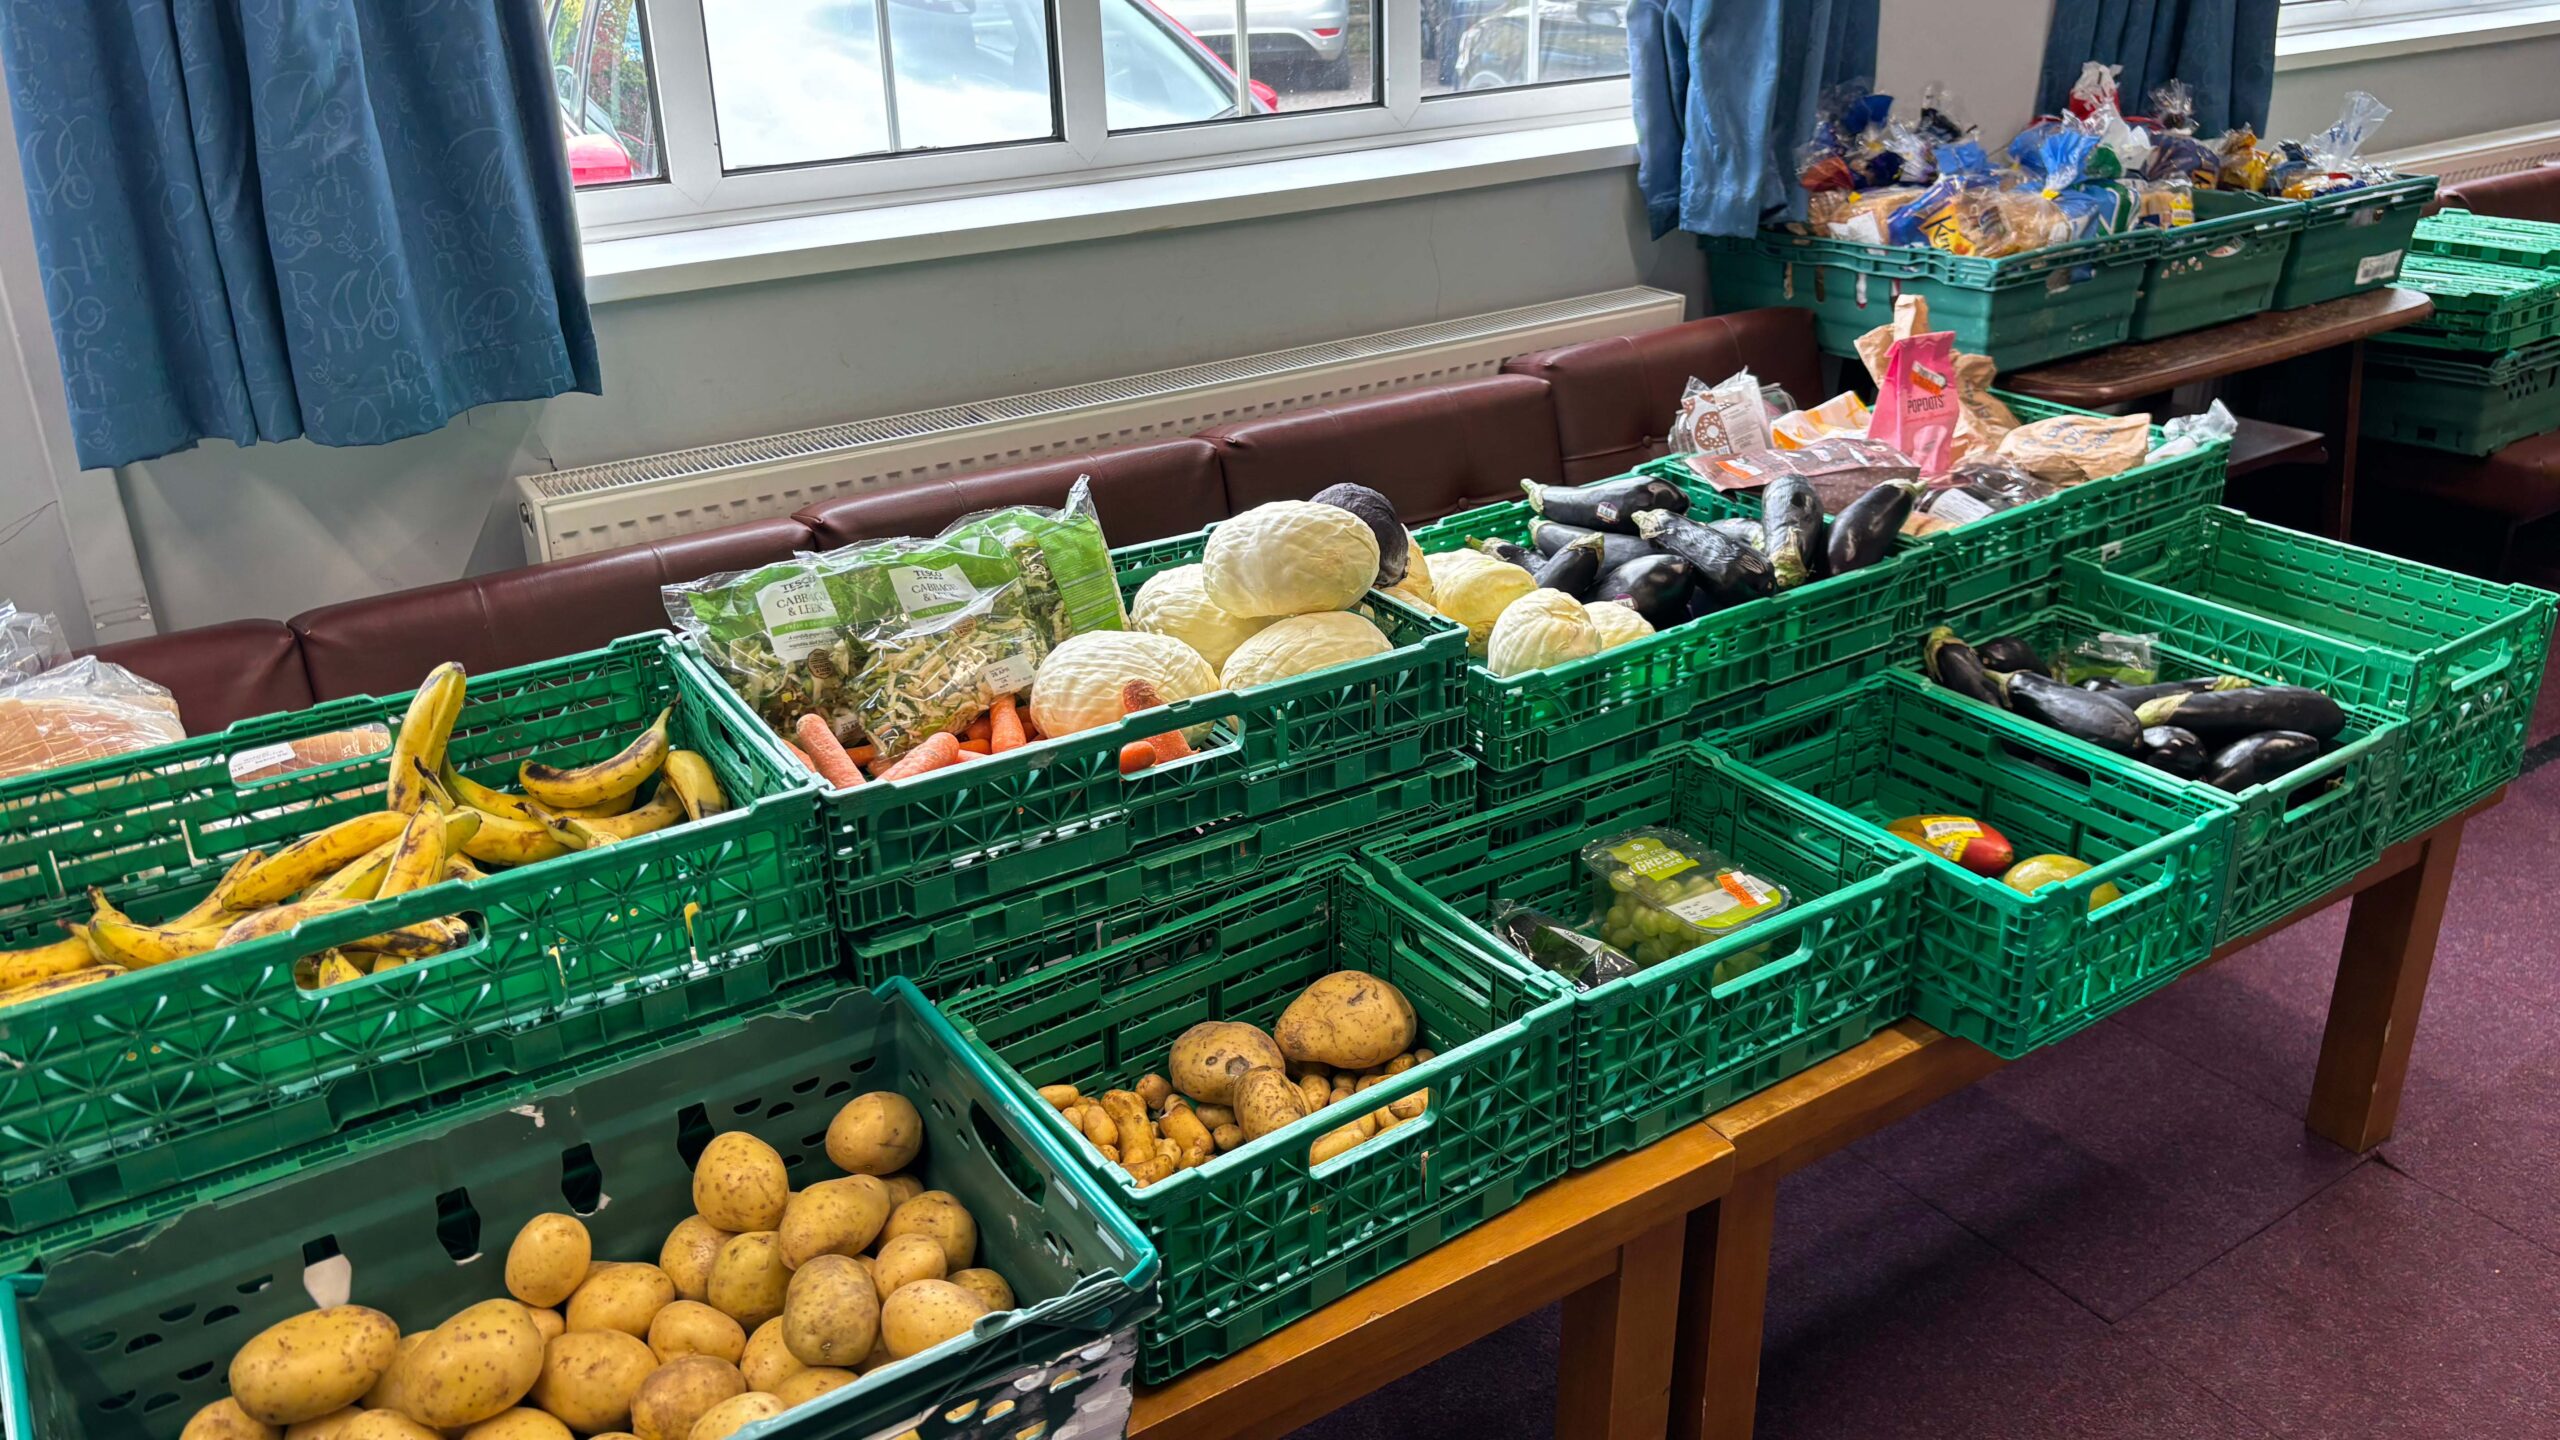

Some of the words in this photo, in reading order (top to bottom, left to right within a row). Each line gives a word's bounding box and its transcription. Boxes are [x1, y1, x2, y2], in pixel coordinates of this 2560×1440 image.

[780, 575, 817, 593] TESCO
[788, 607, 797, 617] &
[1633, 849, 1681, 873] GREEN
